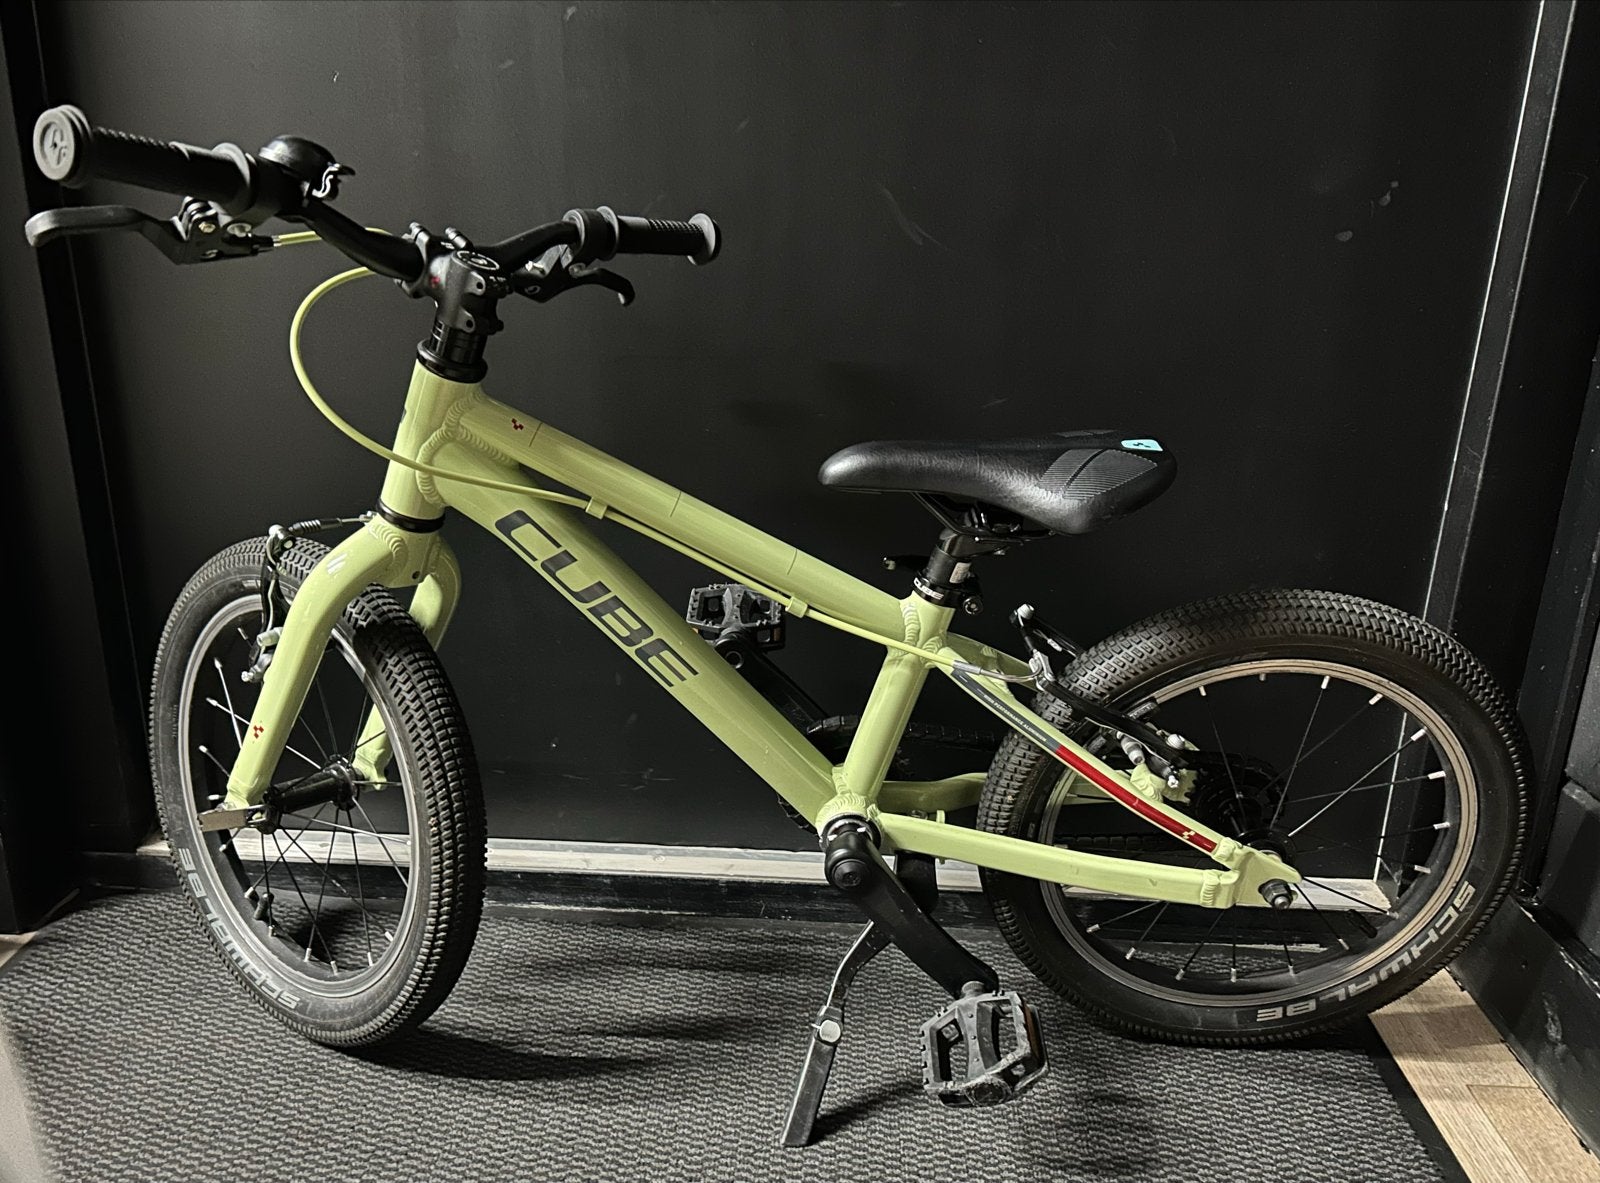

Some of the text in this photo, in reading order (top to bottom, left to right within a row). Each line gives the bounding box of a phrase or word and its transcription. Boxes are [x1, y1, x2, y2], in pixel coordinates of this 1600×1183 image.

[495, 509, 699, 687] CUBE
[178, 848, 301, 1009] SCHWALBE
[1256, 881, 1476, 1022] SCHWALBE
